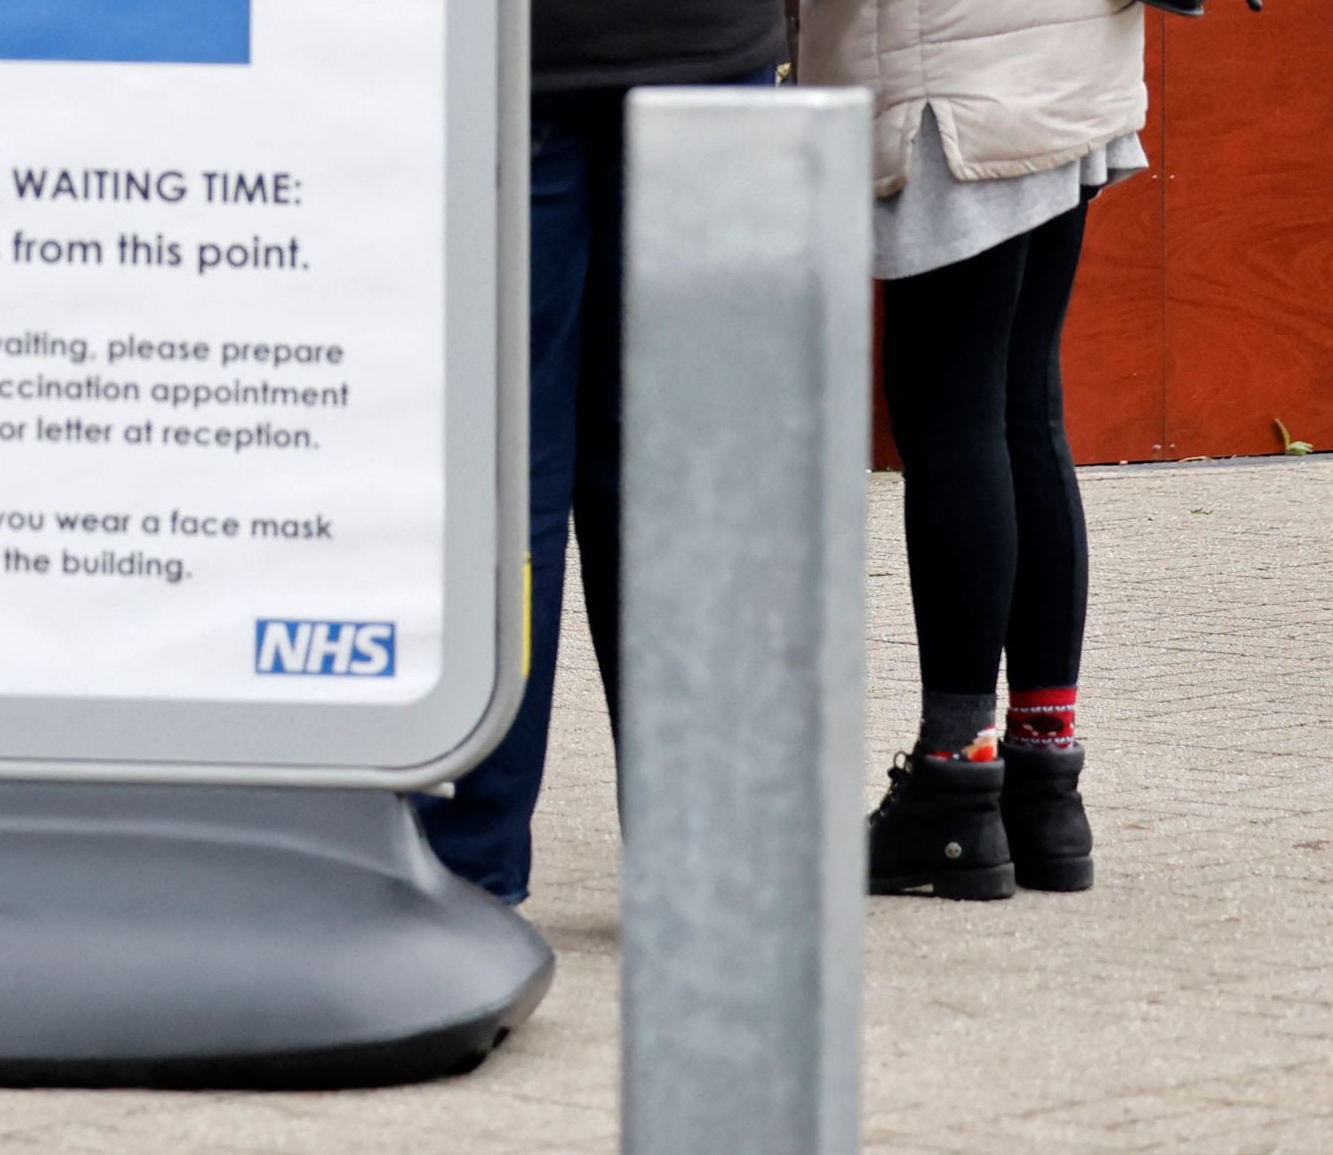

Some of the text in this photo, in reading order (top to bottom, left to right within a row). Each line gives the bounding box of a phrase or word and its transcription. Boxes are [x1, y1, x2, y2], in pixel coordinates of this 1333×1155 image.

[12, 168, 188, 205] WAITING
[202, 171, 303, 206] TIME:
[12, 230, 104, 266] from
[117, 232, 183, 269] this
[196, 234, 311, 275] point.
[107, 335, 211, 364] please
[221, 342, 345, 369] prepare
[151, 379, 349, 408] appointment
[36, 417, 112, 443] letter
[123, 421, 155, 446] at
[161, 424, 320, 453] reception.
[55, 513, 131, 534] wear
[141, 513, 161, 535] a
[170, 510, 240, 537] face
[250, 513, 334, 541] mask
[4, 549, 52, 576] the
[61, 549, 194, 585] building.
[257, 622, 393, 675] NHS
